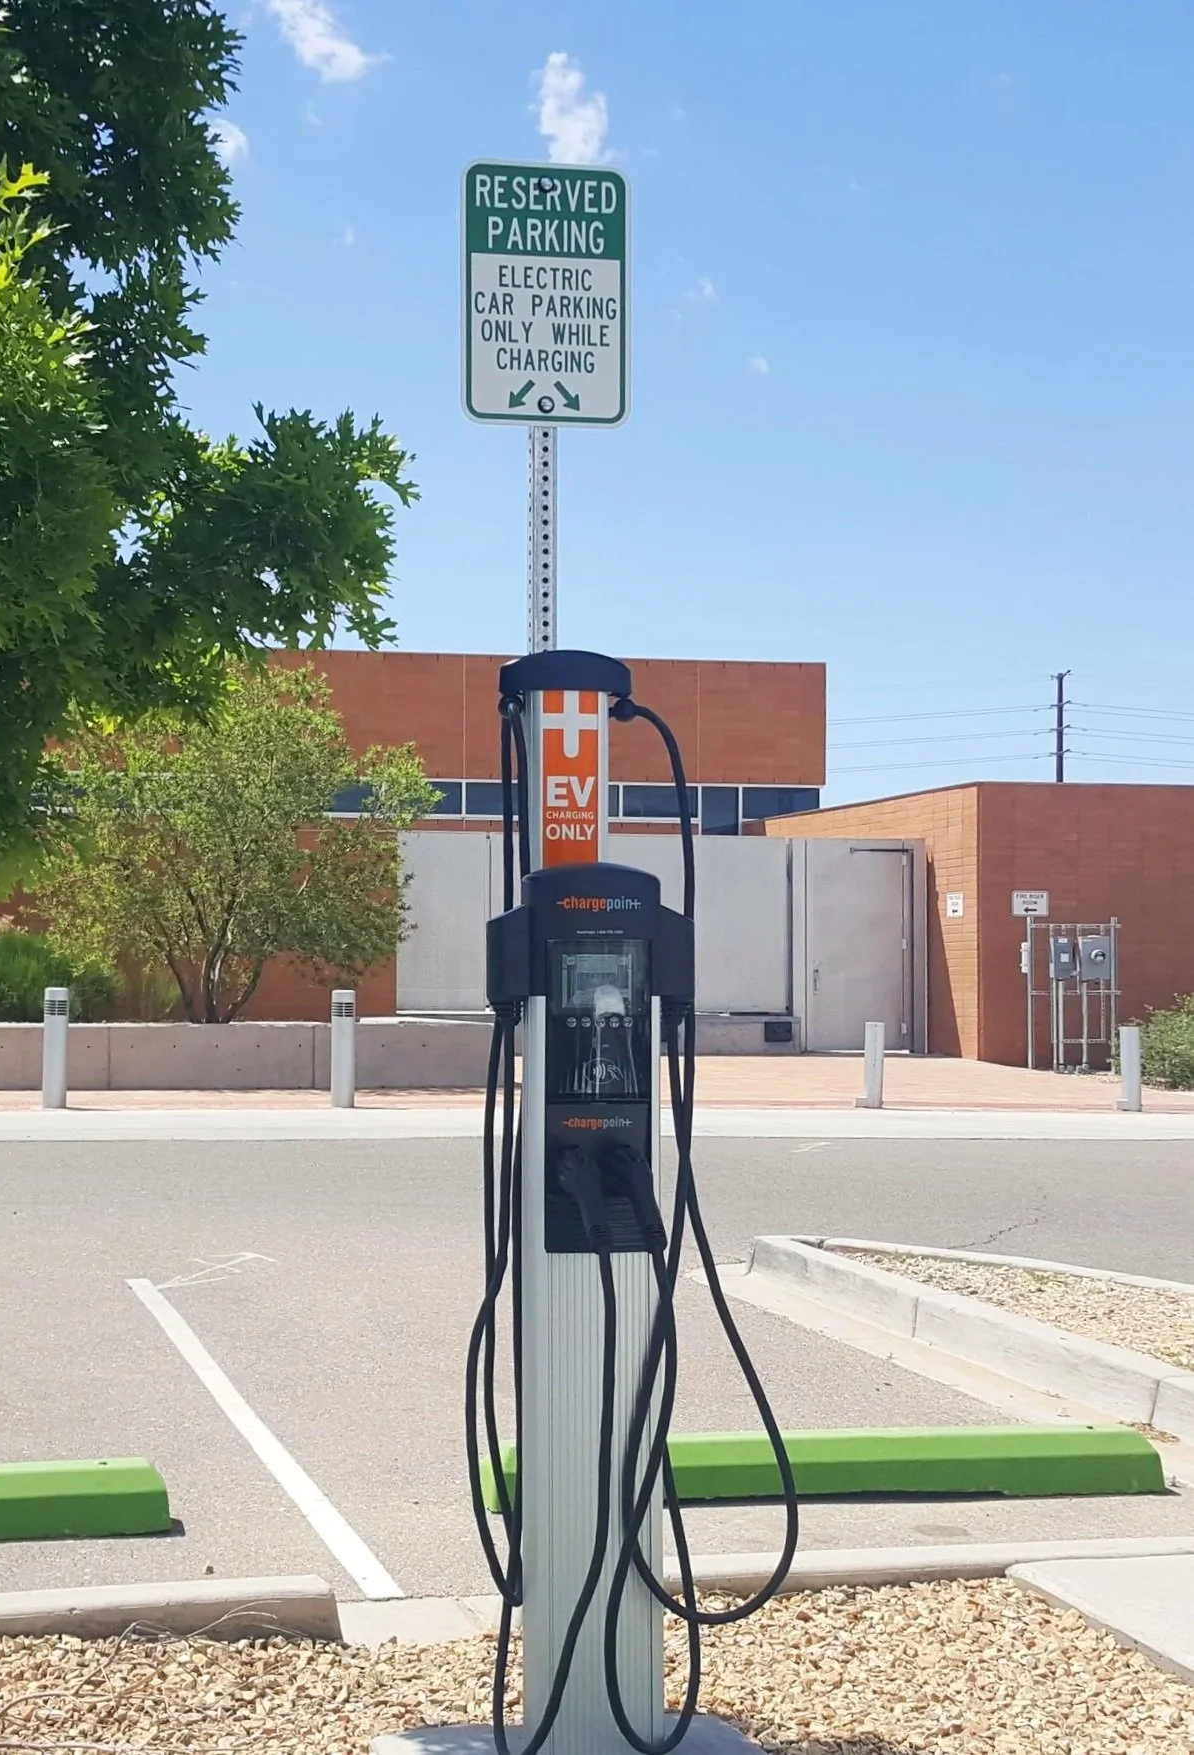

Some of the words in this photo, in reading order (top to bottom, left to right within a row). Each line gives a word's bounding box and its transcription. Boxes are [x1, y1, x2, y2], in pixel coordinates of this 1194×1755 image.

[475, 174, 617, 215] RESERVED
[488, 216, 605, 254] PARKING
[499, 265, 592, 292] ELECTRIC
[474, 291, 514, 316] CAR
[532, 294, 617, 320] PARKING
[481, 319, 533, 343] ONLY
[552, 323, 610, 347] WHILE
[496, 348, 595, 374] CHARGING
[546, 775, 596, 808] EV
[546, 811, 595, 820] CHARGING
[546, 823, 596, 841] ONLY
